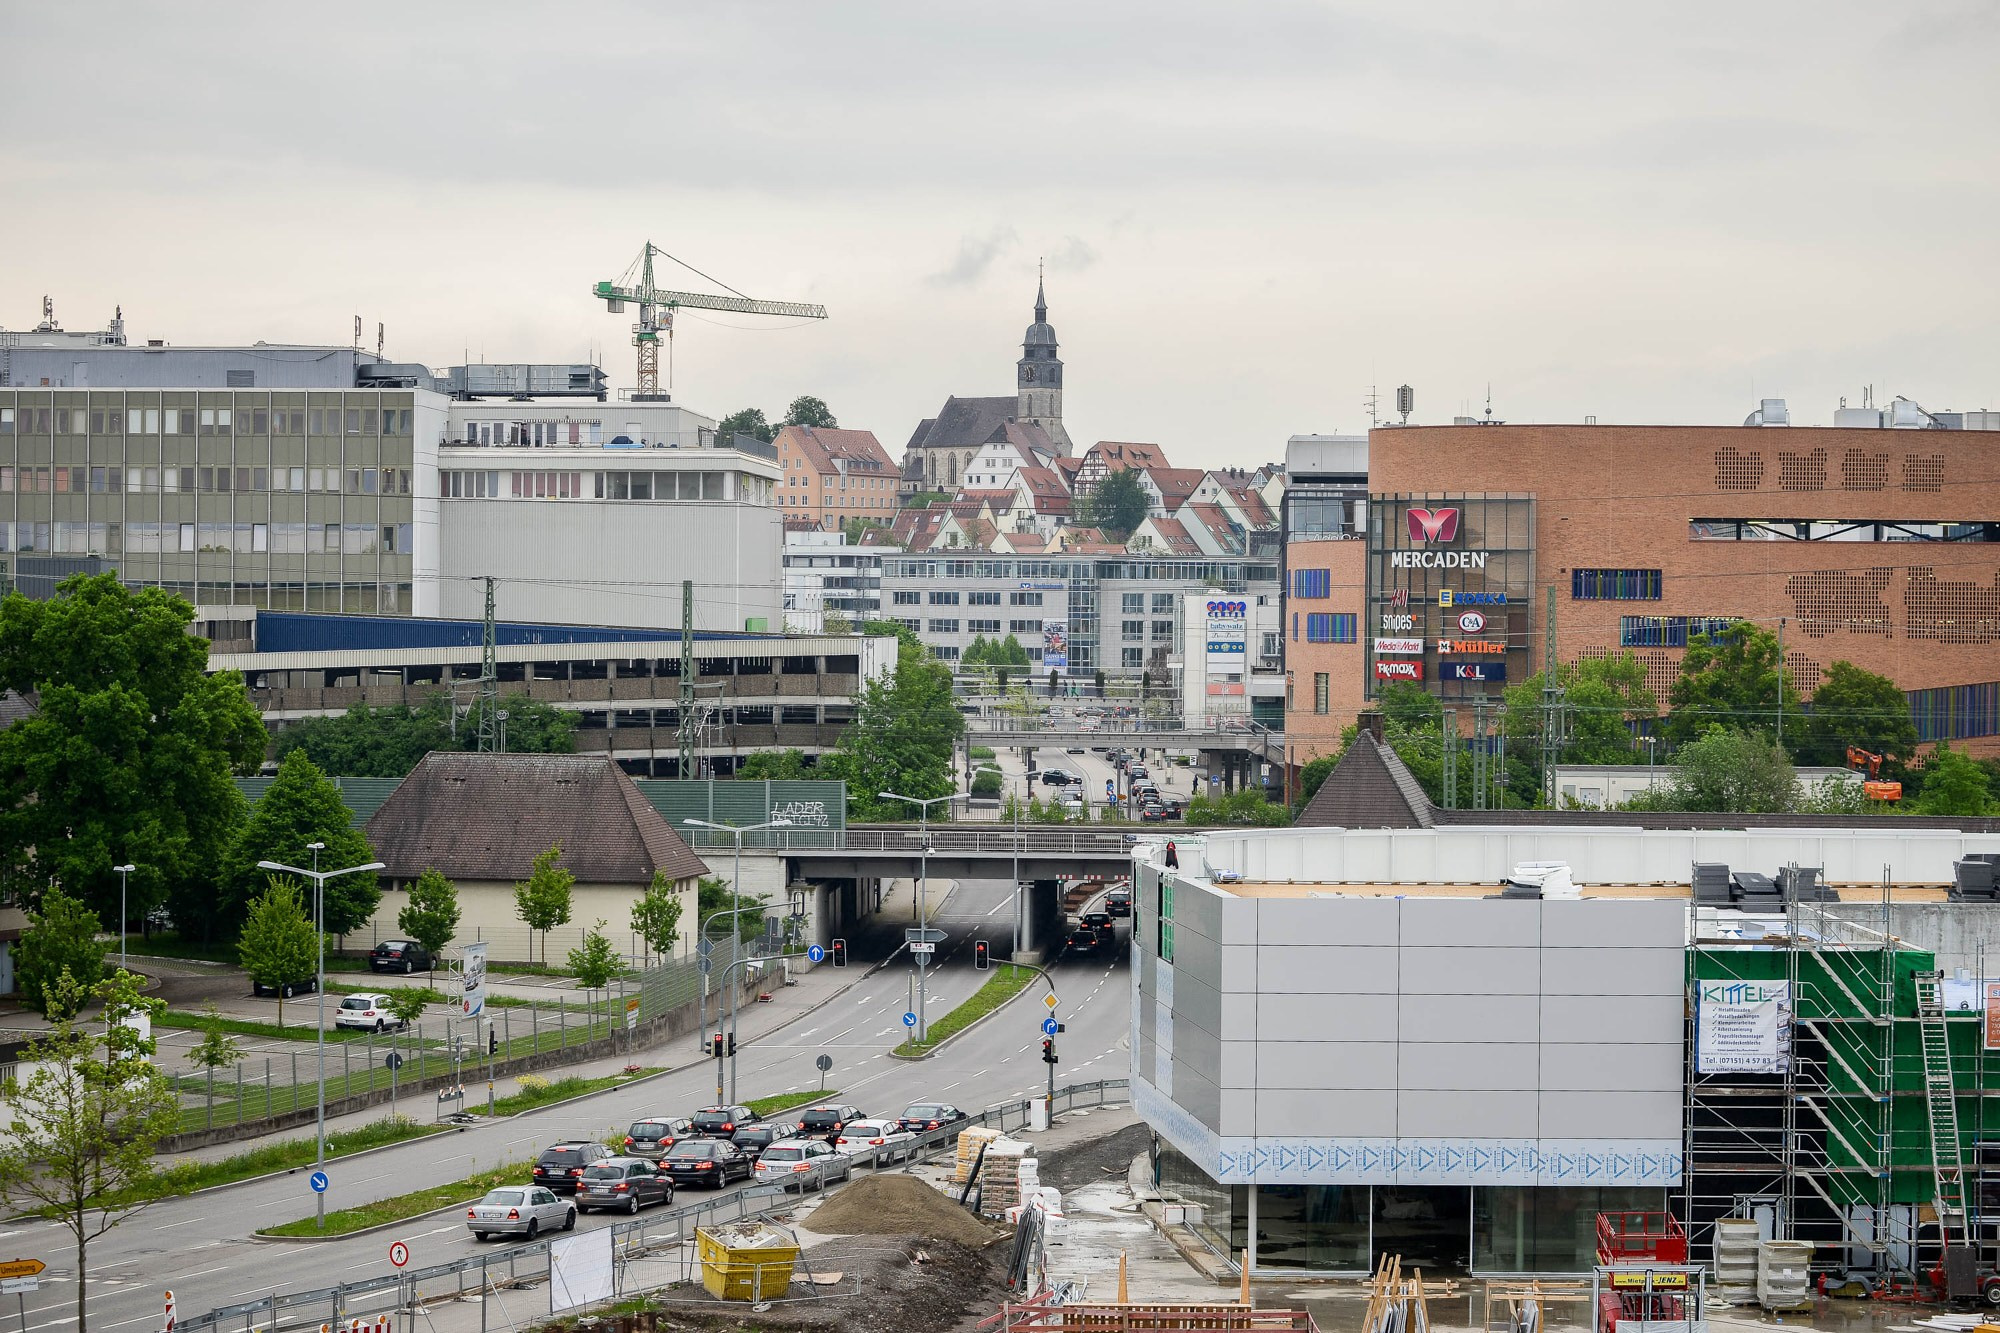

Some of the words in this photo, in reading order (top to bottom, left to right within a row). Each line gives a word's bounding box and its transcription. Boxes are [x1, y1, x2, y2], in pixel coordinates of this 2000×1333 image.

[1391, 589, 1409, 607] H&M
[1454, 593, 1508, 605] EDEKA
[1207, 601, 1246, 612] CITY
[1383, 614, 1412, 632] snipes
[1462, 617, 1481, 628] C&A
[1376, 641, 1396, 650] Media
[1400, 641, 1419, 650] Markt
[1454, 641, 1505, 654] Müller
[1456, 665, 1485, 678] K&L
[1704, 983, 1773, 1005] KITTEL
[1719, 1057, 1744, 1065] (07151)
[1, 1265, 36, 1274] Umleitung
